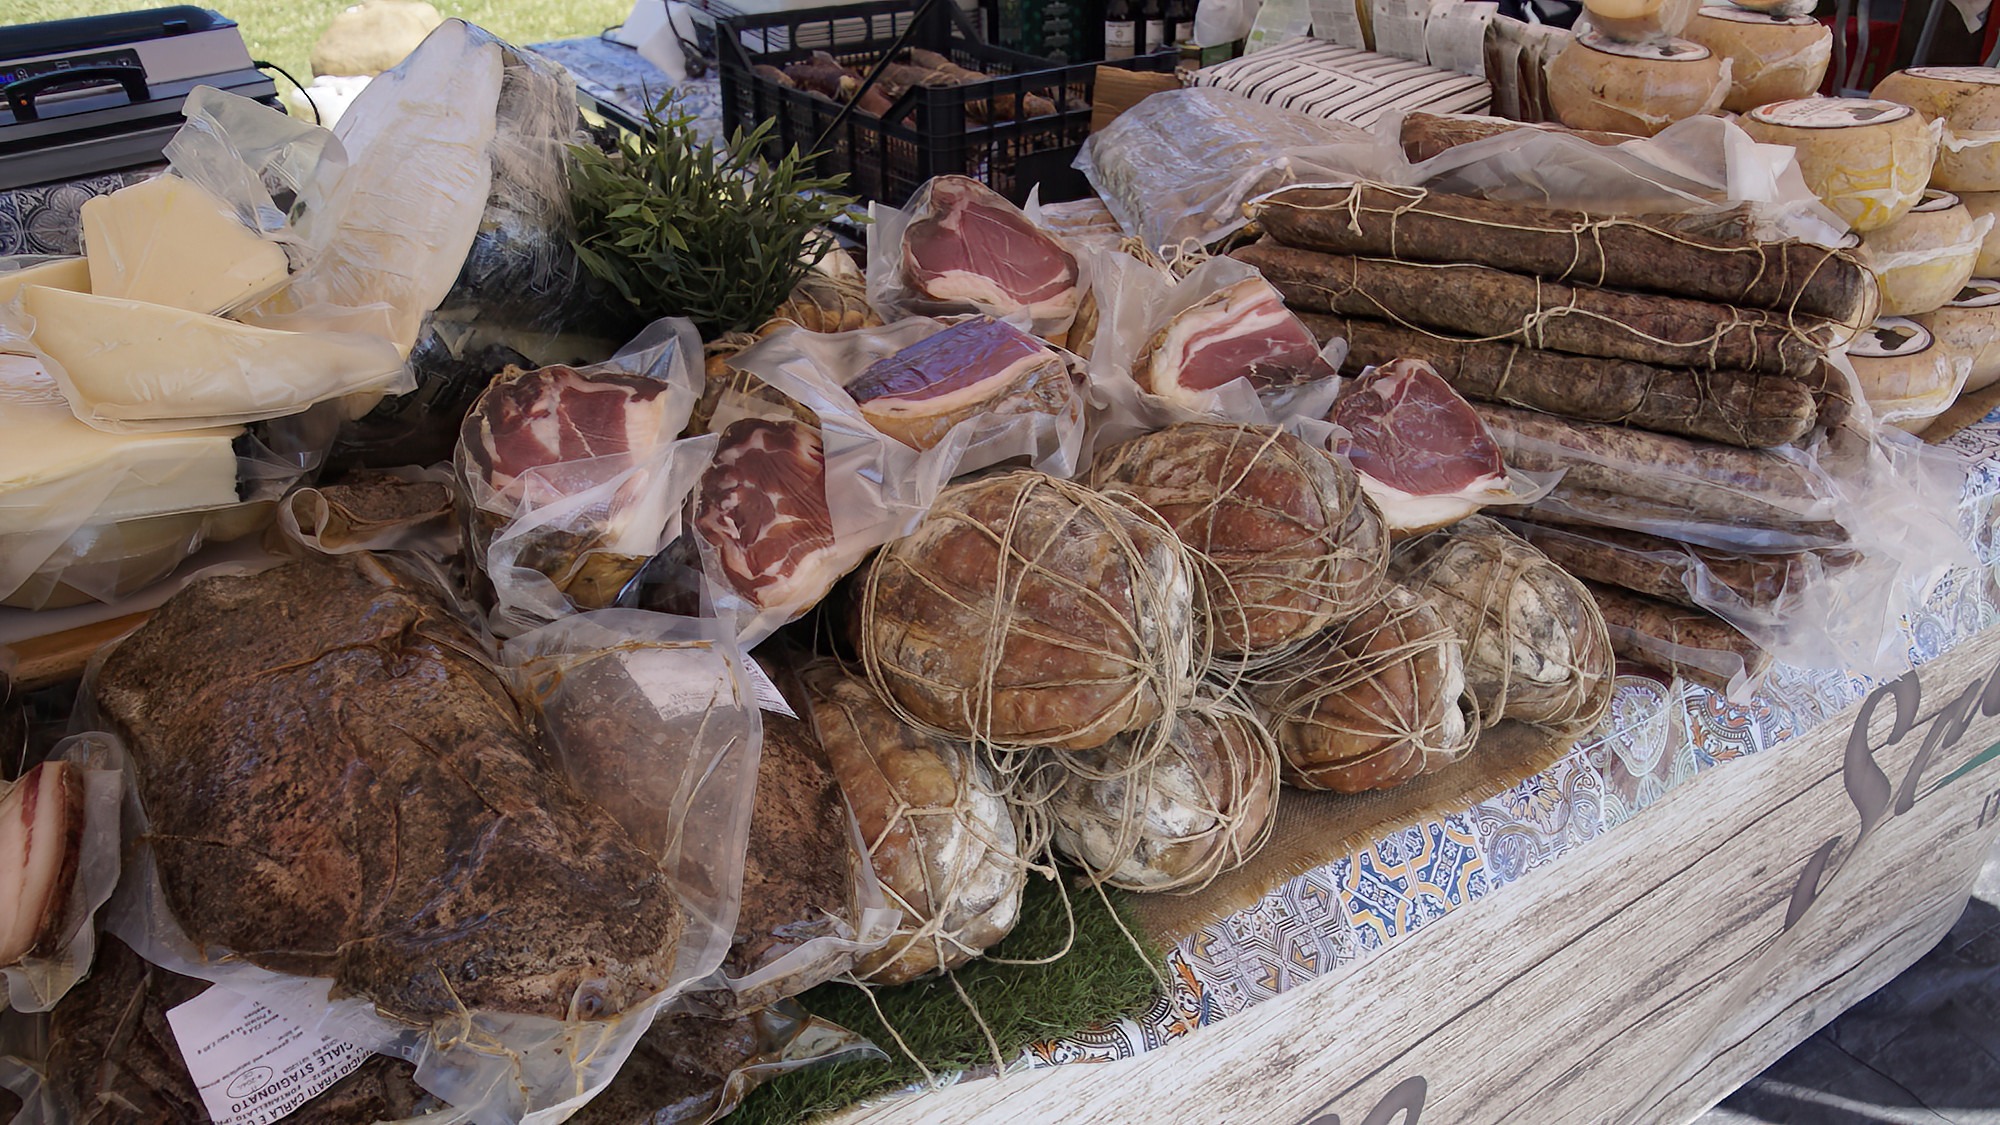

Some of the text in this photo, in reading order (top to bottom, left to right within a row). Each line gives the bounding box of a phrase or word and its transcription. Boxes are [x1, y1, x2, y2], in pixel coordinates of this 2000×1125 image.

[230, 1039, 353, 1114] CIALE STAGIONATO
[306, 1071, 338, 1096] FRATI
[268, 1092, 305, 1119] CARLA
